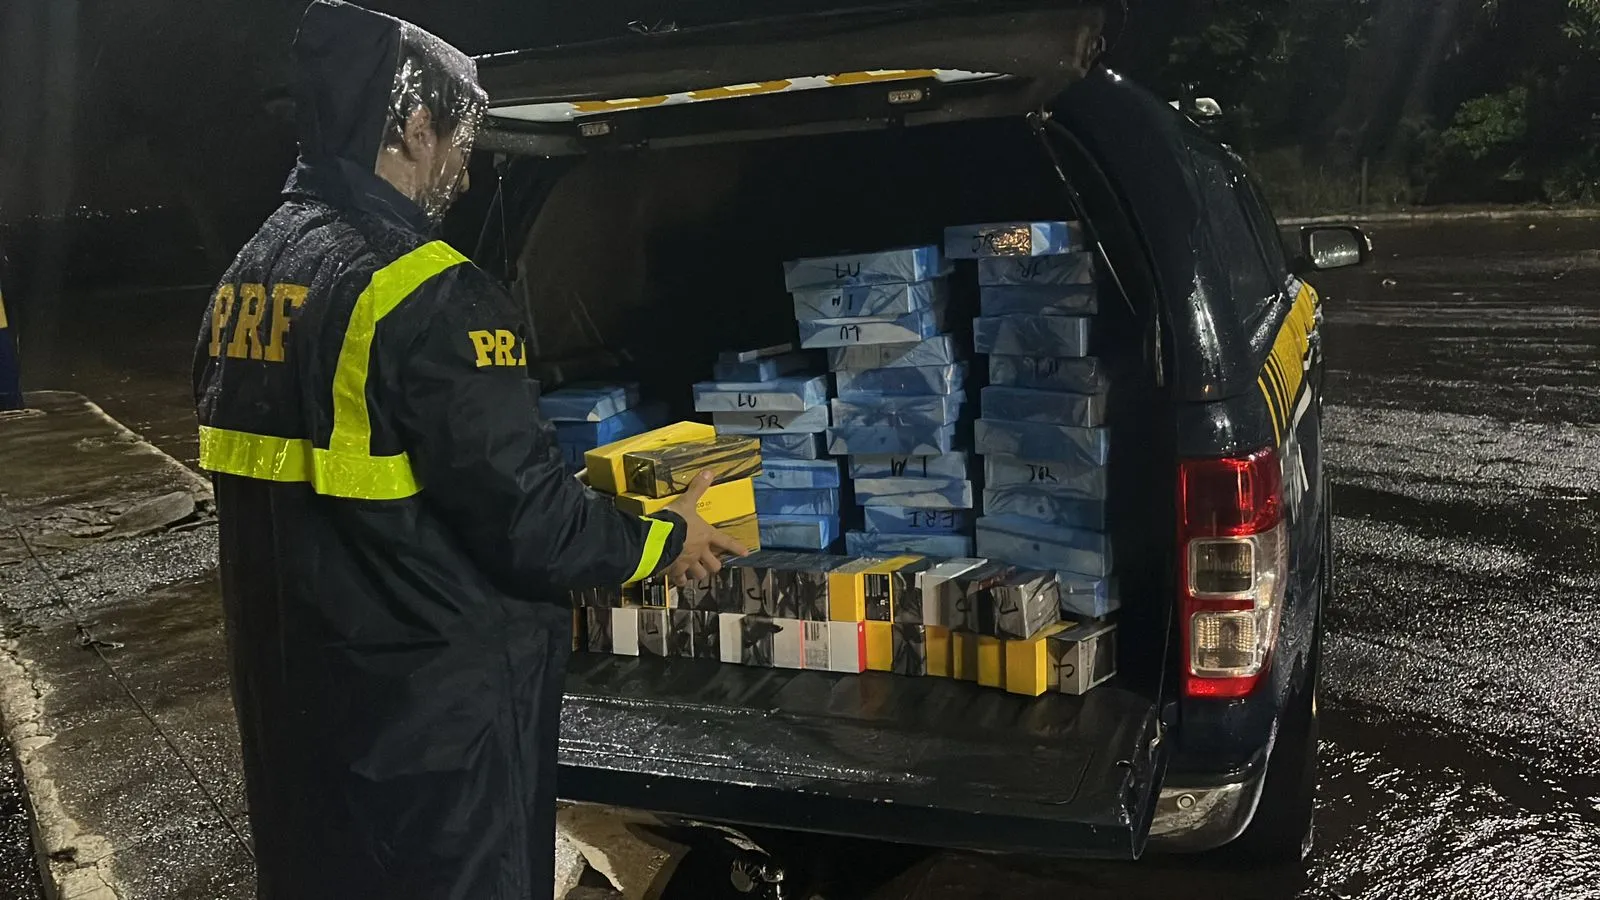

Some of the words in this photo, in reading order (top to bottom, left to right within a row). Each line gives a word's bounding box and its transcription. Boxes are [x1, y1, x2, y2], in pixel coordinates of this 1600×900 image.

[209, 283, 309, 362] PRF
[738, 393, 757, 408] LU
[753, 415, 785, 430] JR
[908, 511, 954, 528] ERI
